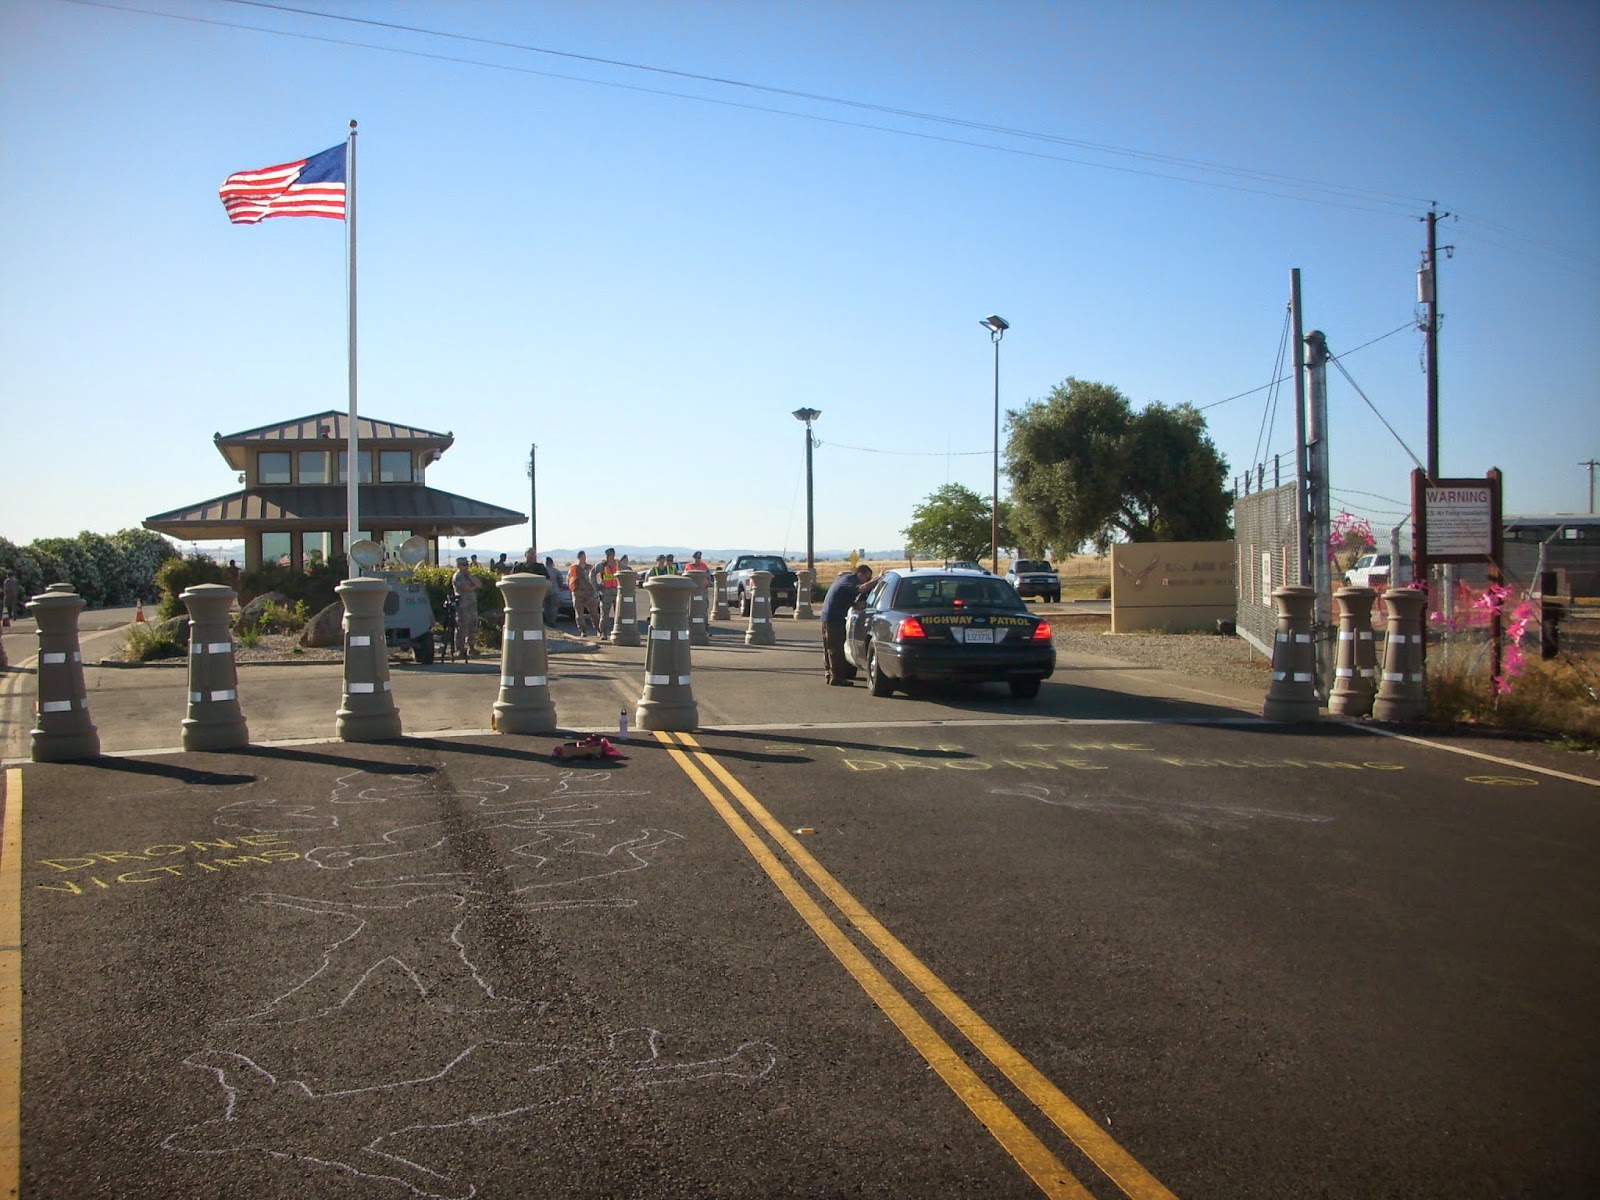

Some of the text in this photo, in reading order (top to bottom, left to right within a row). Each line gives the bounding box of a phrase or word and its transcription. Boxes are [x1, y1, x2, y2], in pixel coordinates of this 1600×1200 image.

[1427, 491, 1488, 503] WARNING
[921, 616, 973, 624] HIGHWAY
[989, 616, 1031, 626] PATROL
[842, 758, 1109, 772] DRONE
[36, 833, 295, 872] DRONE
[37, 848, 301, 895] VICTIMS
